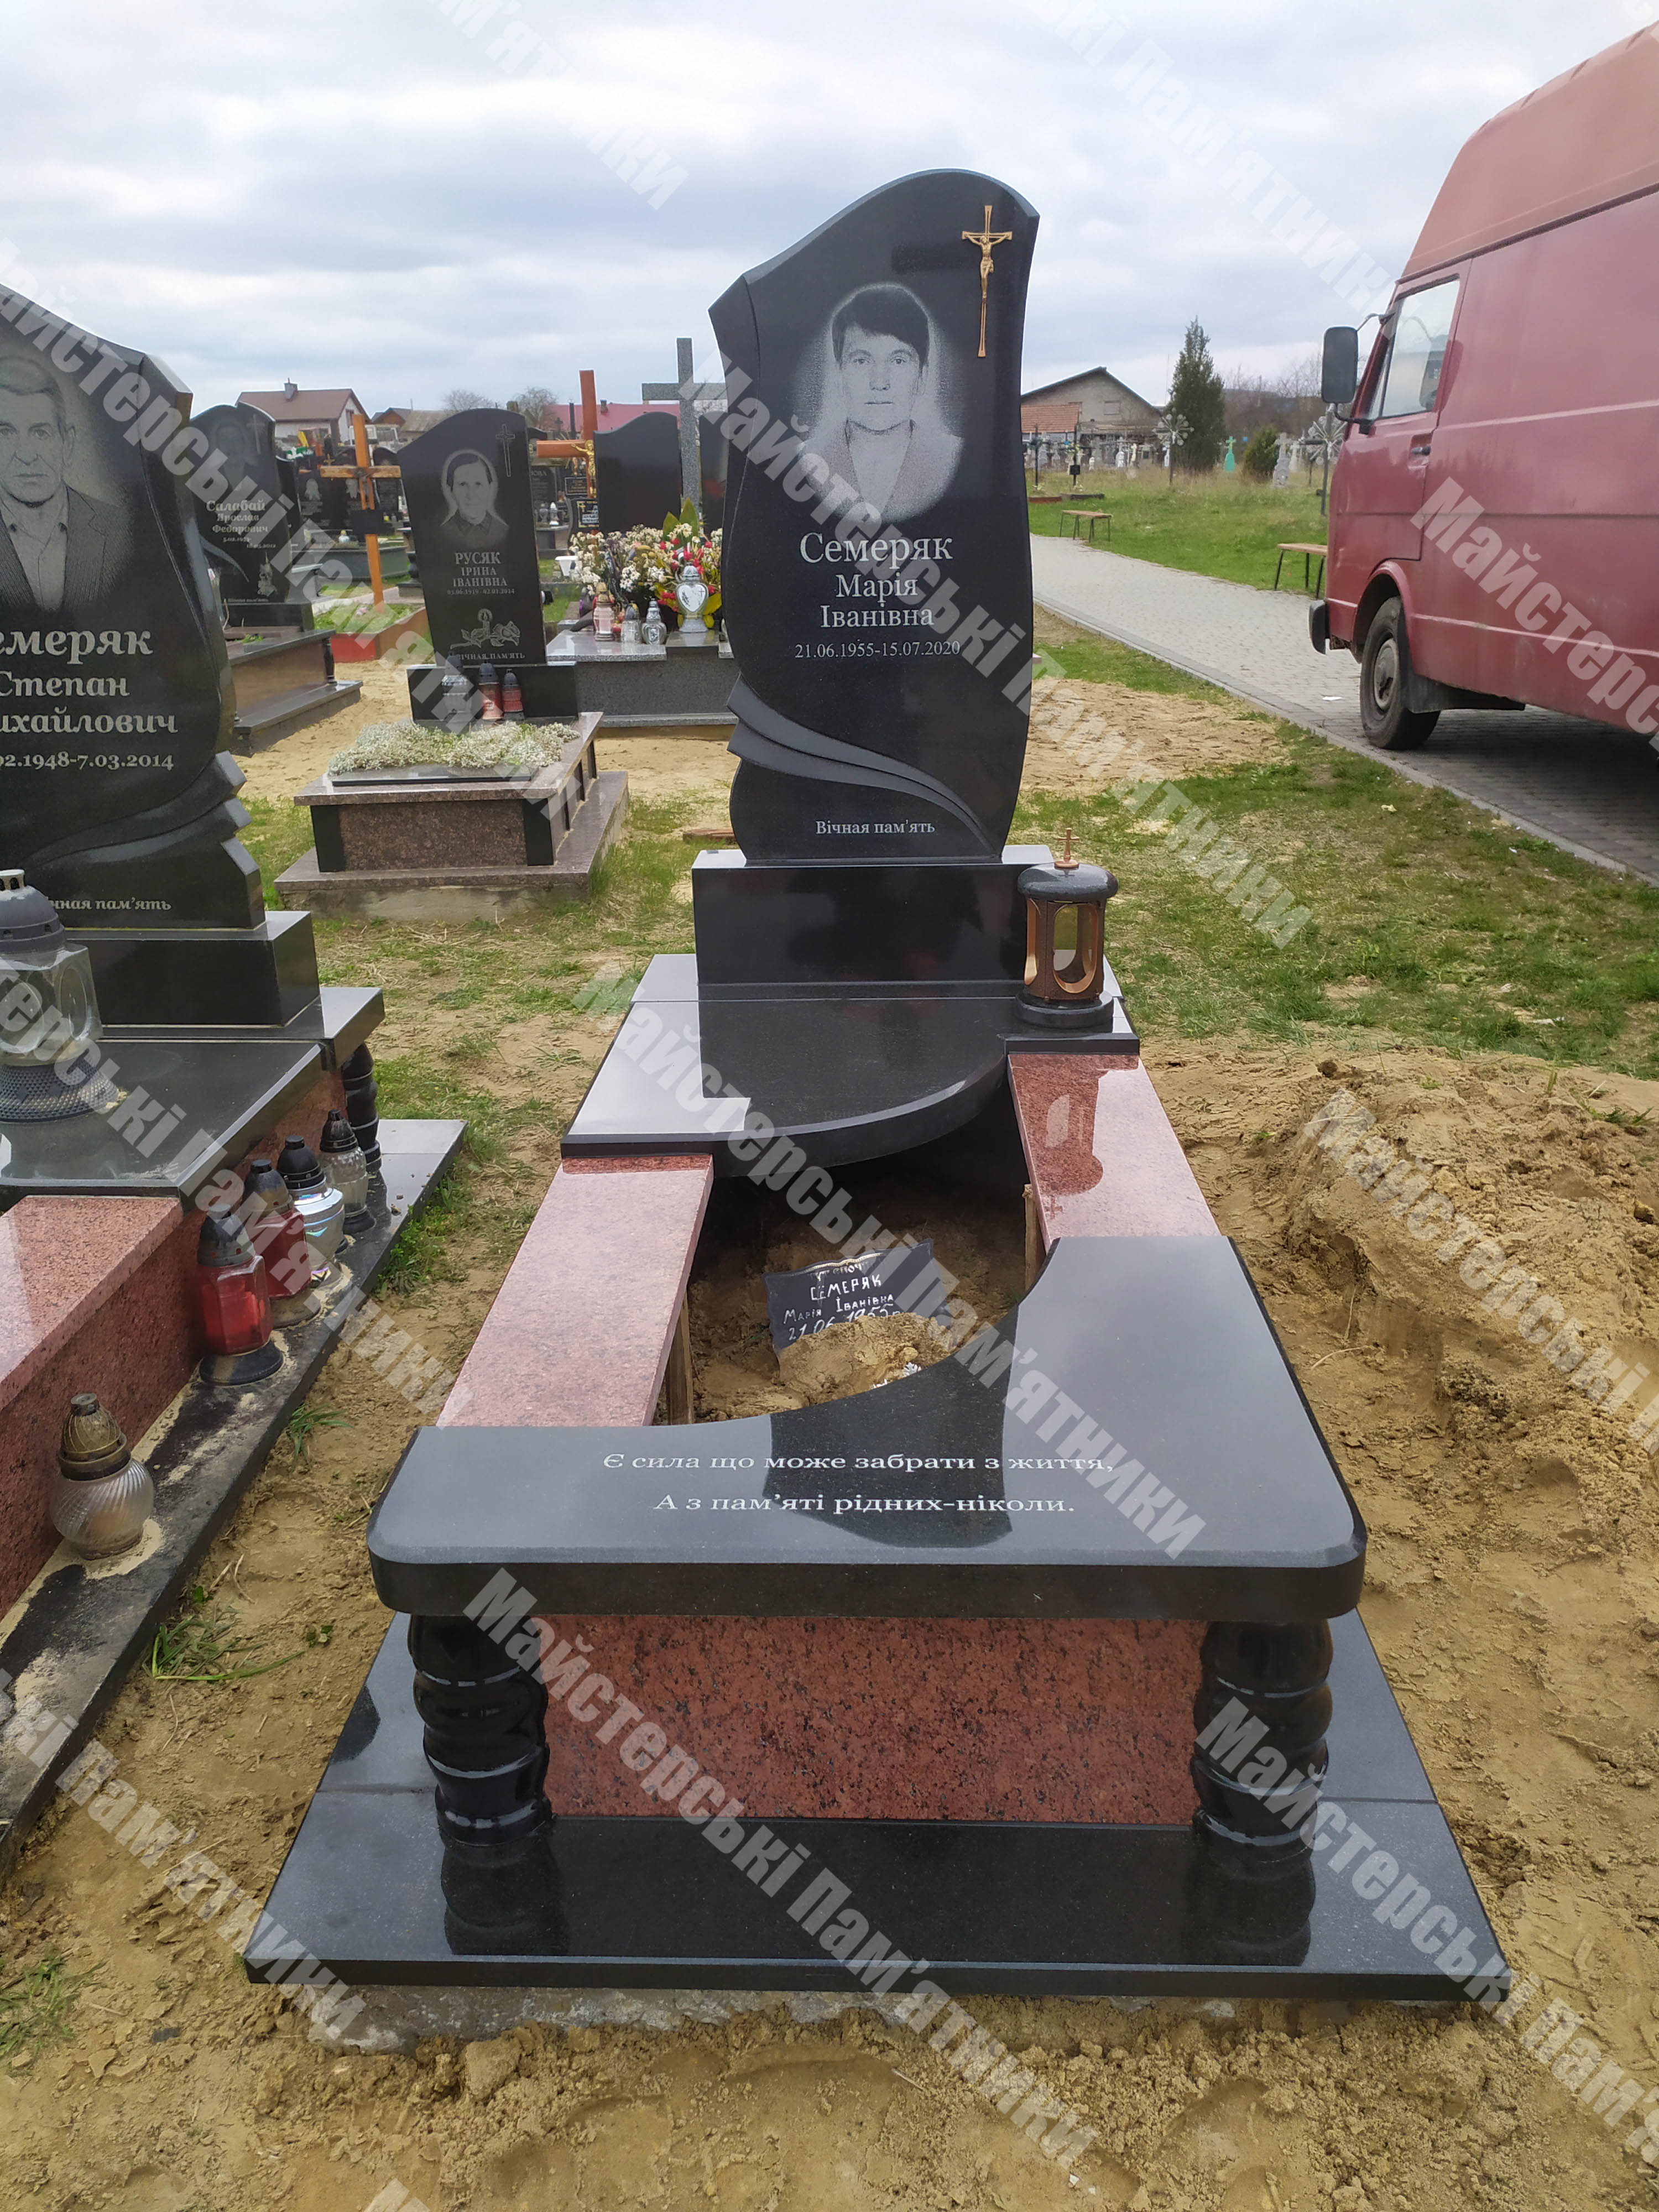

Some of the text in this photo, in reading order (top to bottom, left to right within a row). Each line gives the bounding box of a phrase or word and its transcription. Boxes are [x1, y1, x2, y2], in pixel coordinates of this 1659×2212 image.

[456, 552, 502, 565] РУСЯК
[800, 533, 953, 569] Семеряк
[461, 567, 497, 576] ІРИНА
[453, 577, 508, 587] ІВАНІВНА
[836, 572, 918, 603] Марія
[821, 603, 934, 628] Іванівна
[0, 630, 153, 665] меряк
[795, 641, 960, 658] 21.06.1955-15.07.2020
[816, 819, 935, 834] Вічная пам'ять
[96, 897, 171, 910] пам'ять
[603, 1454, 1114, 1472] Є сила що може забрати з життя,
[653, 1494, 1074, 1514] А з пам'яті рідних-ніколи.
